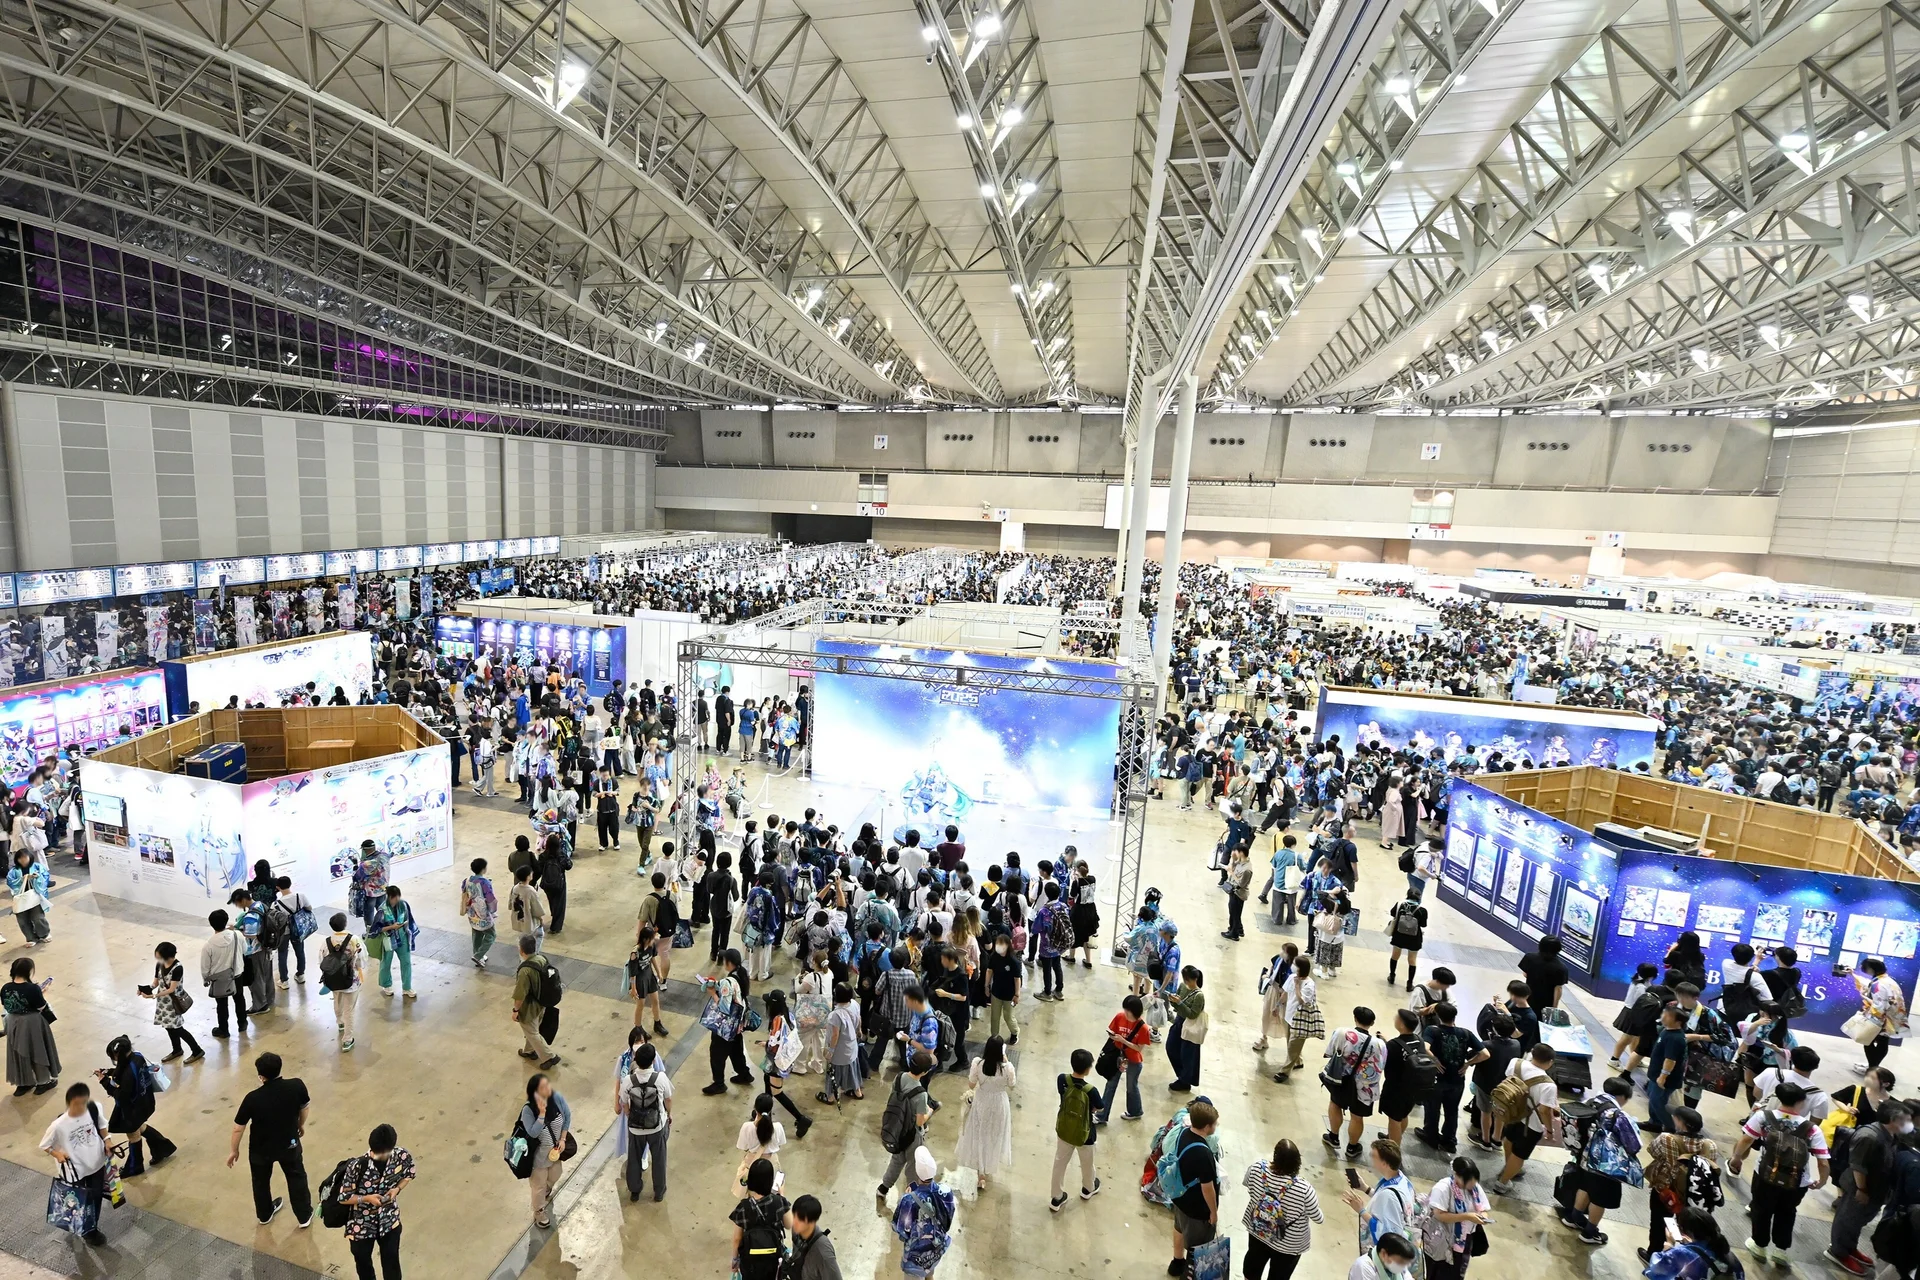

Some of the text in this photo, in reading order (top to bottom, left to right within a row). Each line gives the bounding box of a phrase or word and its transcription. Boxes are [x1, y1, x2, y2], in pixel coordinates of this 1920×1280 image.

[875, 507, 885, 516] 10
[1433, 529, 1445, 539] 11
[1583, 599, 1609, 607] YAMAHA
[941, 690, 979, 703] 2025
